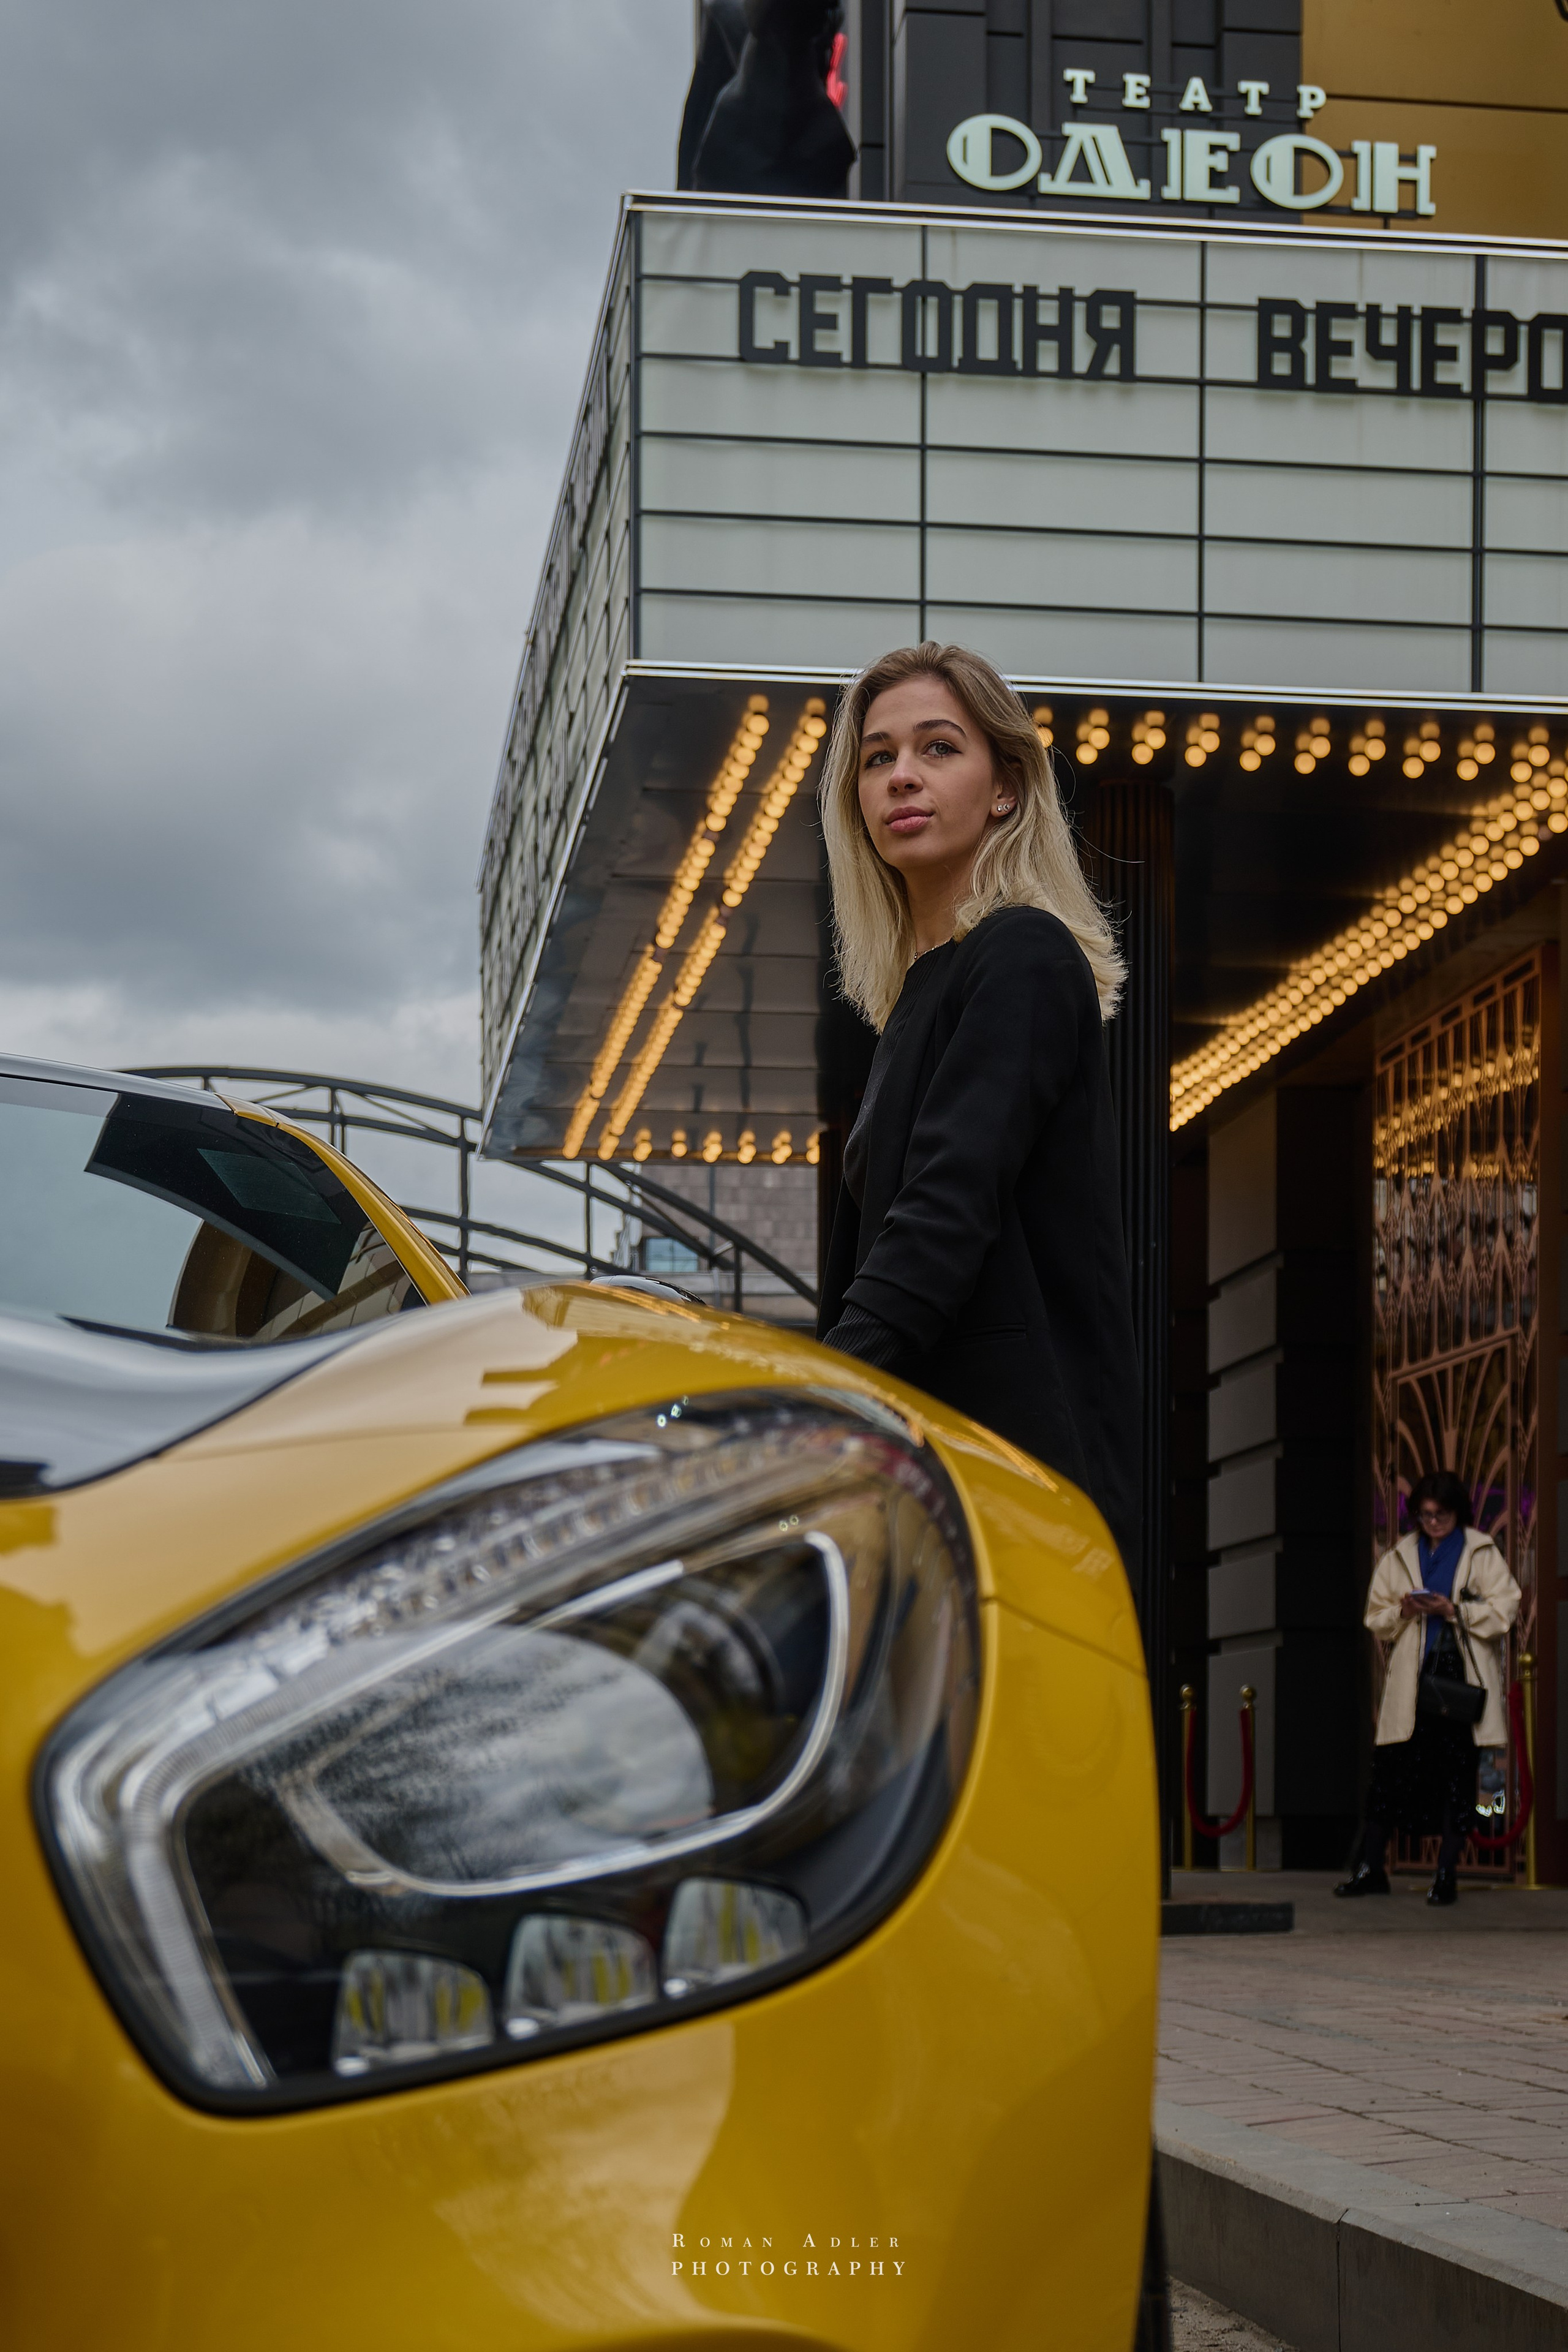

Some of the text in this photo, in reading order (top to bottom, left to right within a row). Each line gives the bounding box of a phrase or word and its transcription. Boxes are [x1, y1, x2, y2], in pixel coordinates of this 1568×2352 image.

[1064, 69, 1327, 118] ТЕАТР
[947, 113, 1436, 216] ОДЕОН
[739, 270, 1137, 382] СЕГОДНЯ
